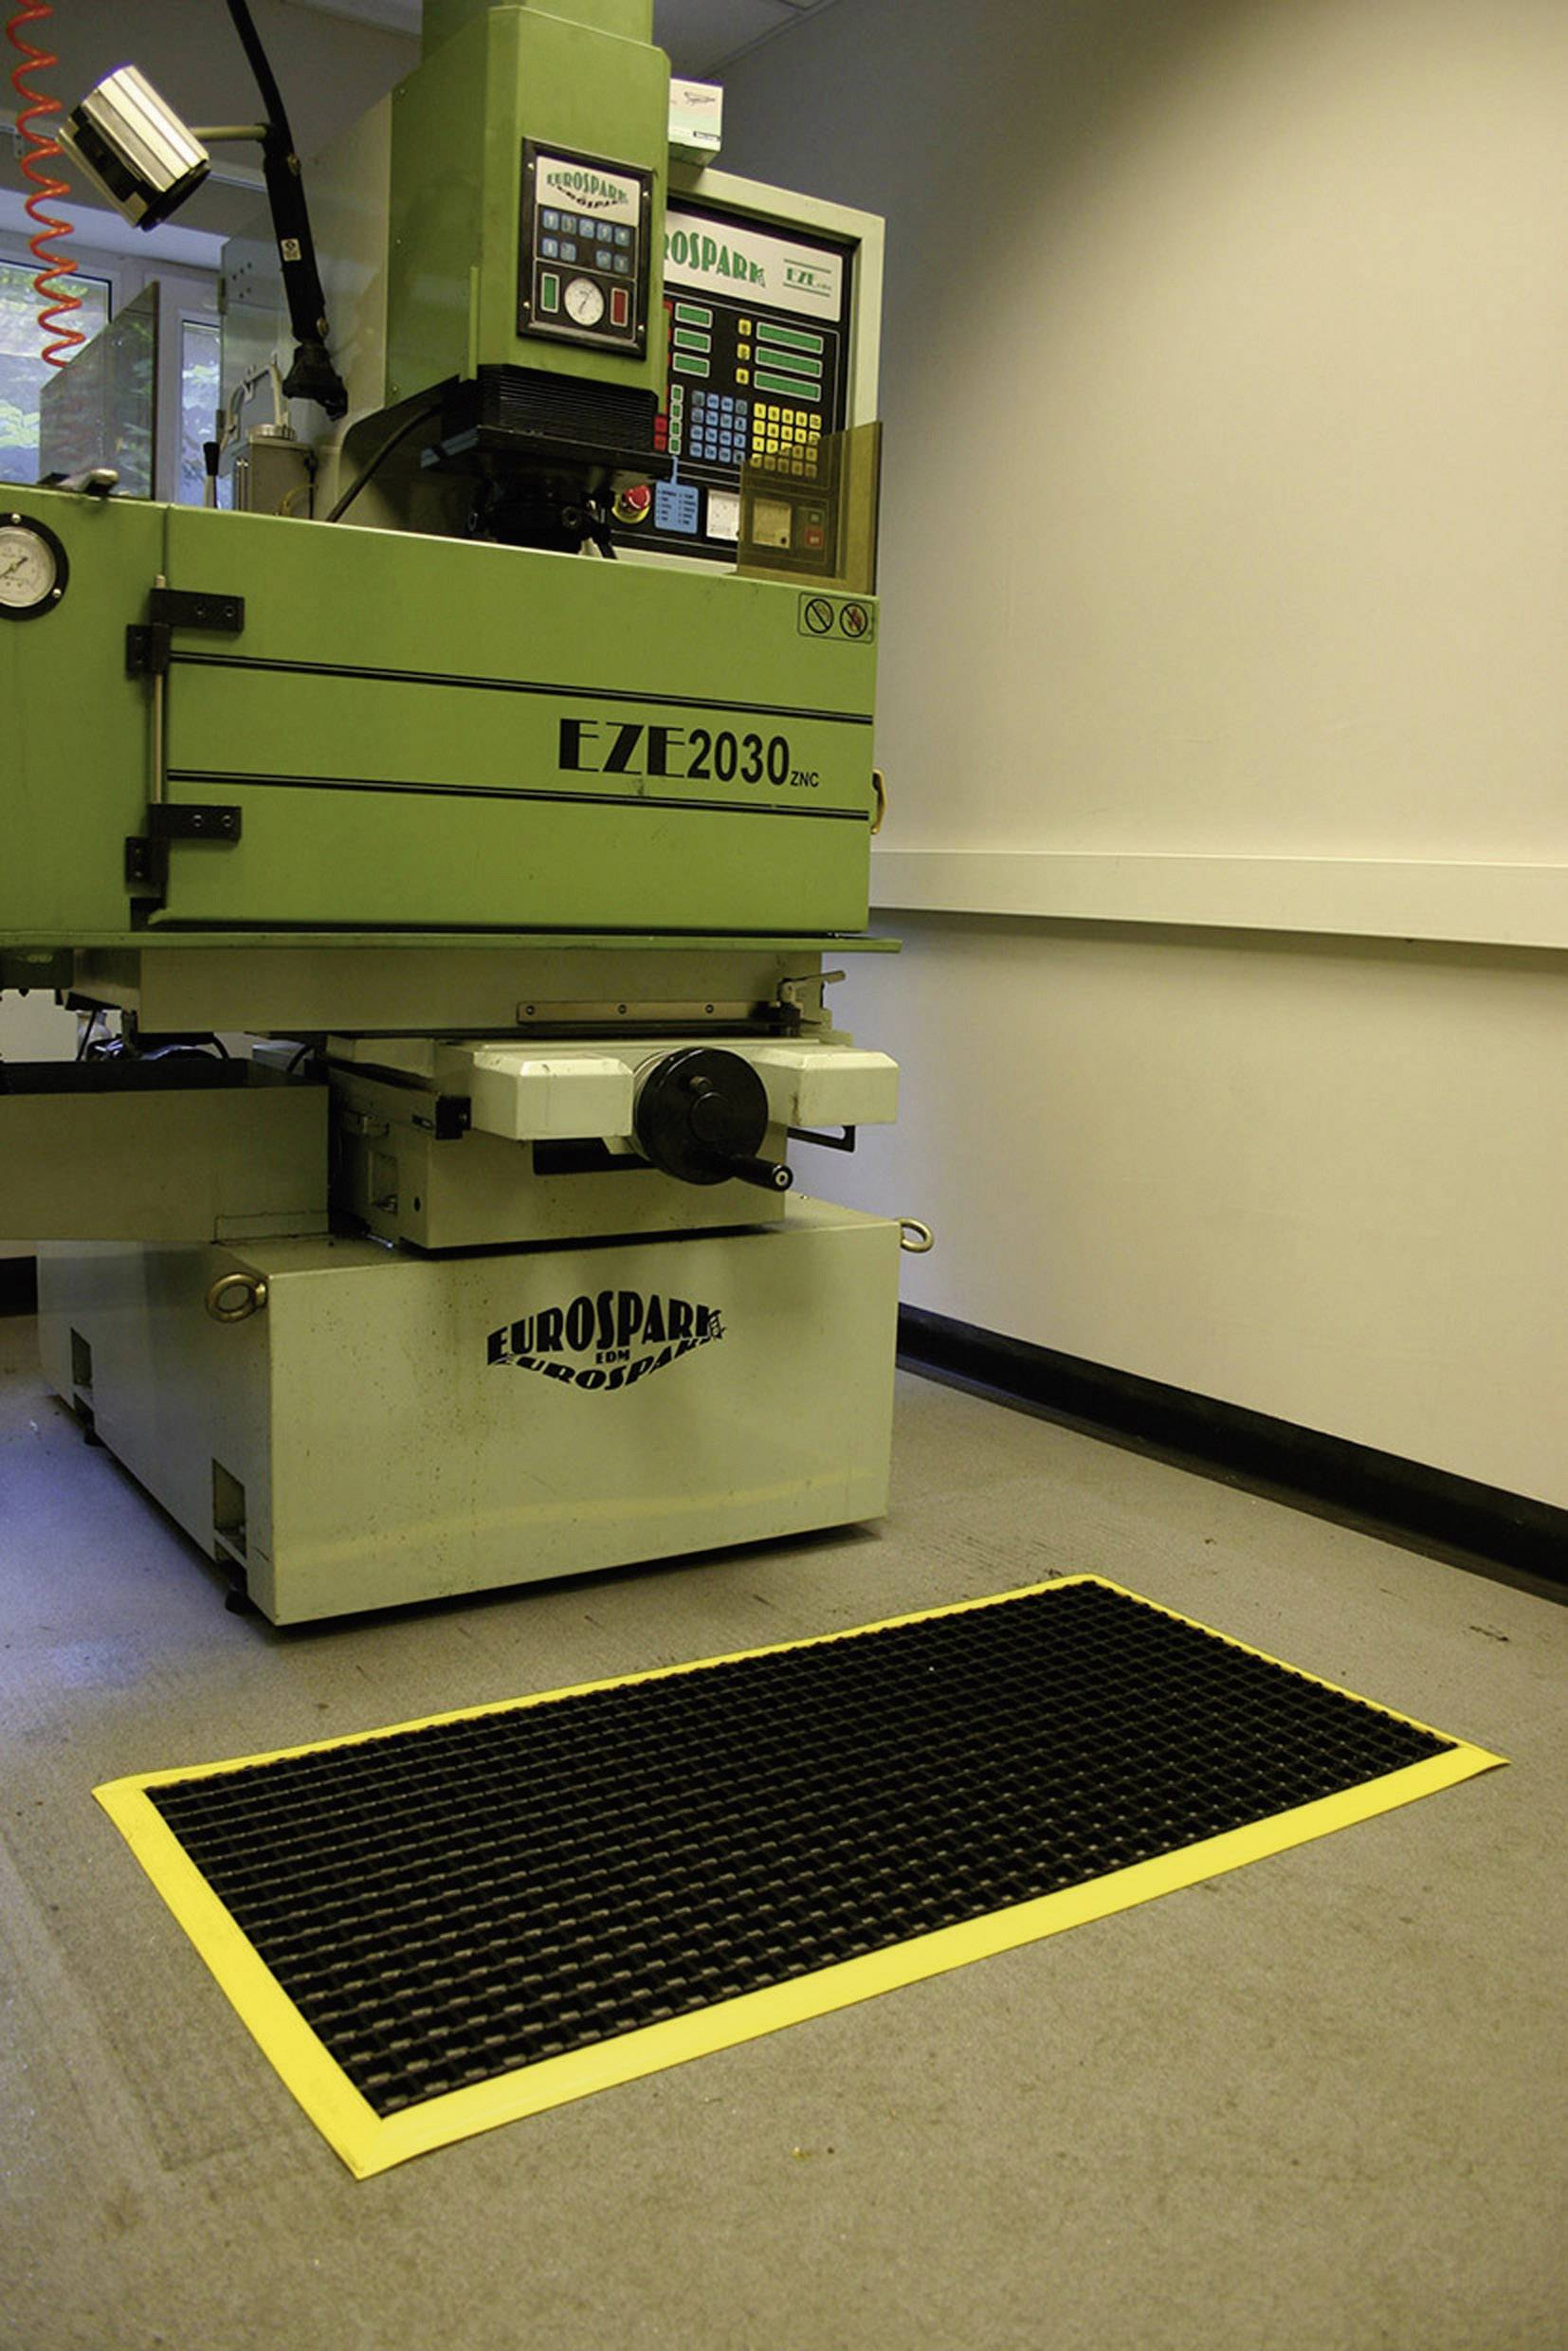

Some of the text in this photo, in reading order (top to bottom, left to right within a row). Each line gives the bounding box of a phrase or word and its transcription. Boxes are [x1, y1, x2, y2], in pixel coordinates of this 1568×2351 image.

[790, 770, 820, 788] ZNC
[486, 1290, 726, 1366] EUROSPARK
[595, 1349, 630, 1364] EDM
